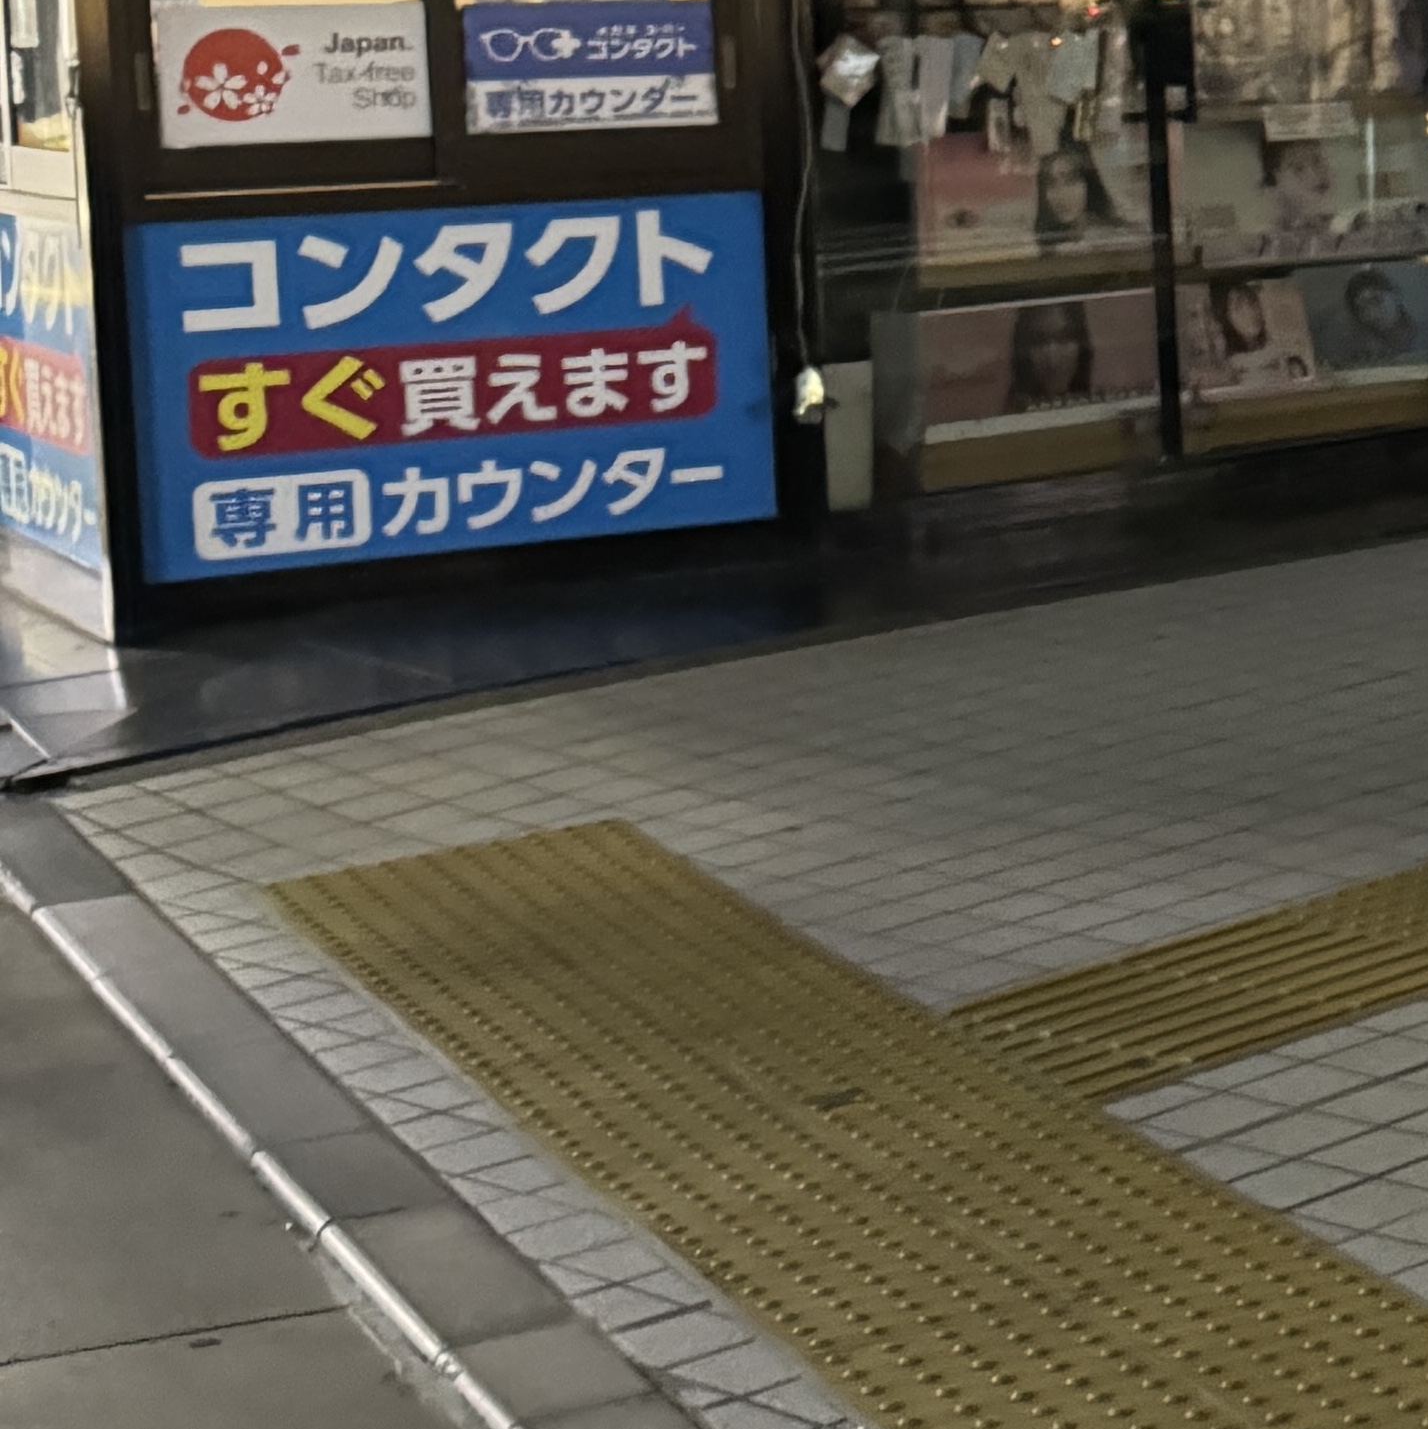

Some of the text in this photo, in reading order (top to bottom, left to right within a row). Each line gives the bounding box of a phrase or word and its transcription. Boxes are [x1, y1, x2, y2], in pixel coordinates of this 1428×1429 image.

[586, 36, 697, 61] コンタクト
[352, 86, 417, 110] Shop
[179, 209, 714, 333] コンタクト
[198, 339, 708, 453] すぐ買えます
[210, 447, 724, 541] 専用カウンター
